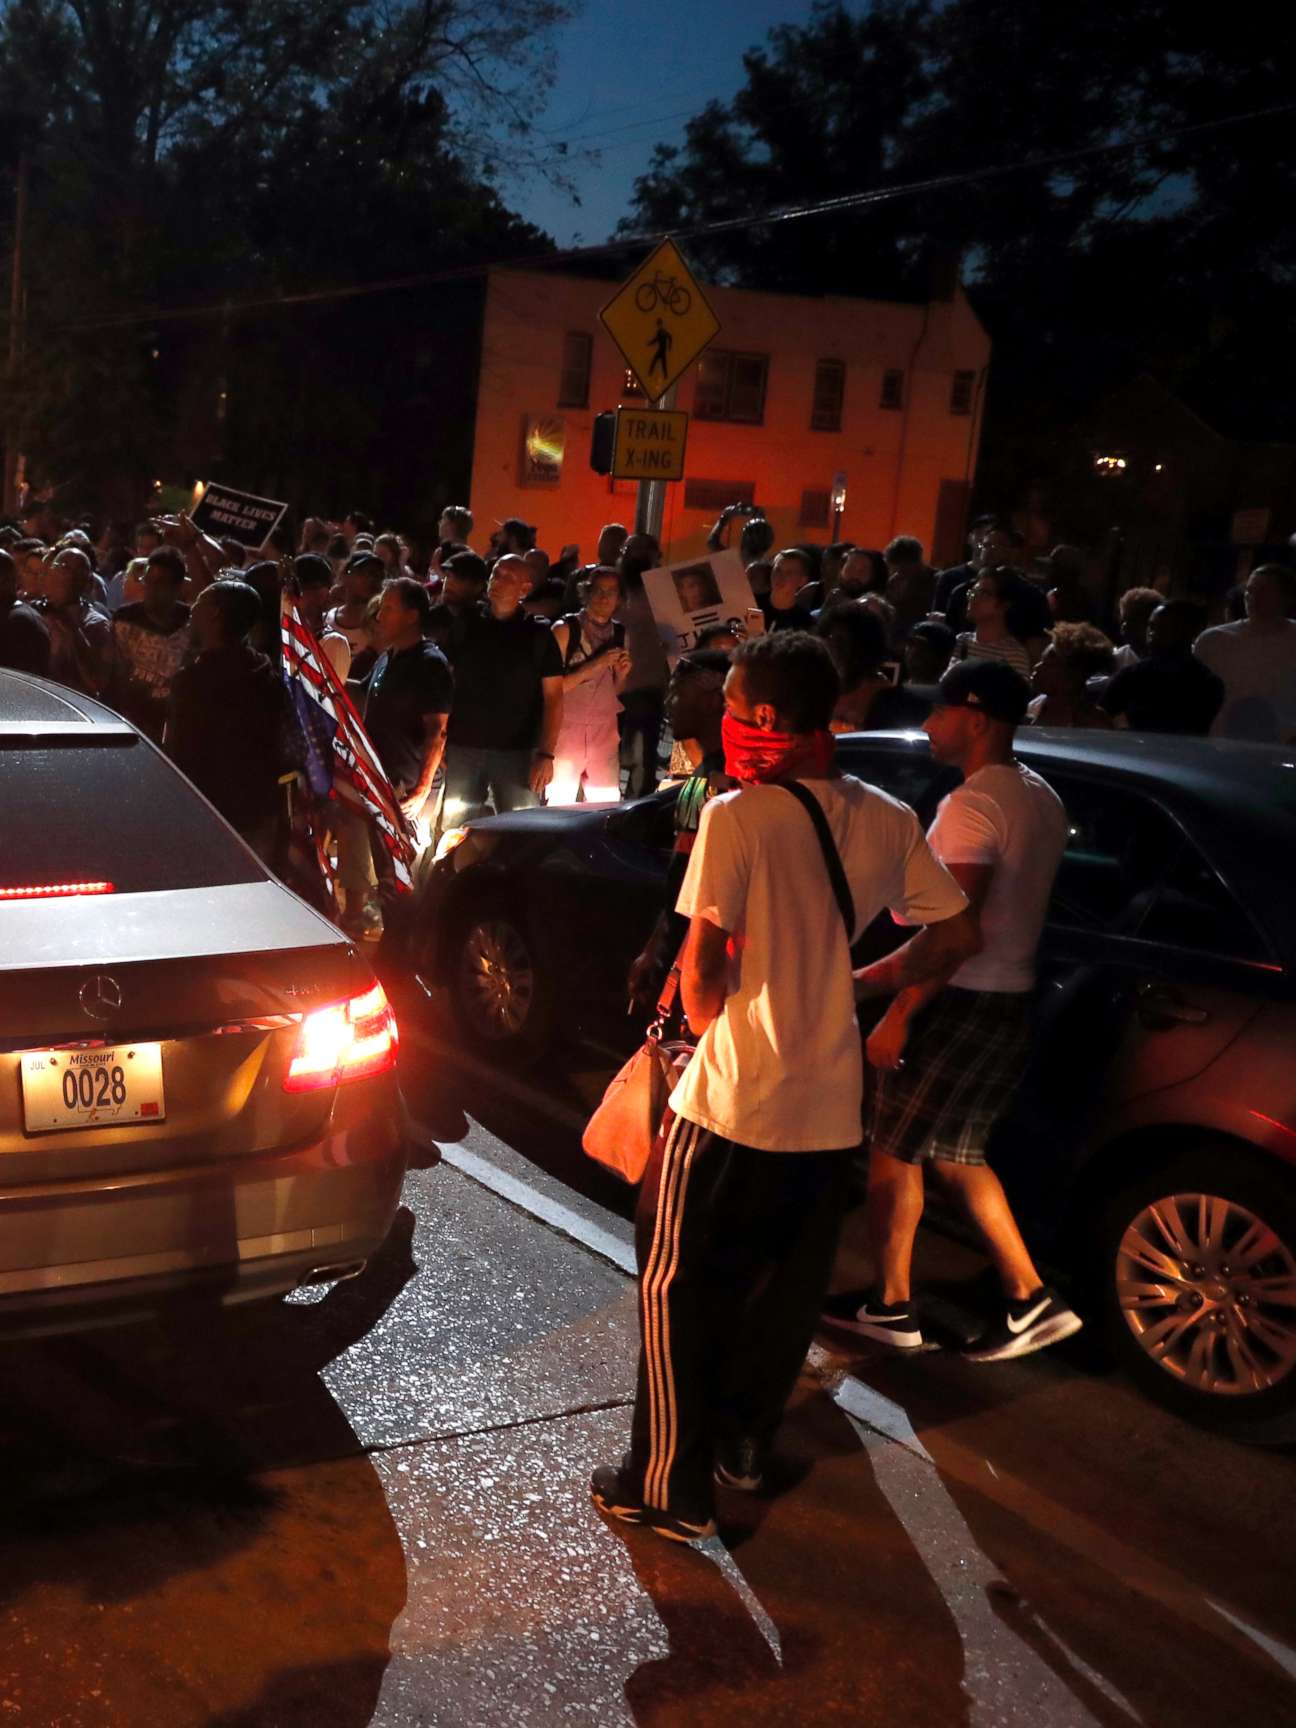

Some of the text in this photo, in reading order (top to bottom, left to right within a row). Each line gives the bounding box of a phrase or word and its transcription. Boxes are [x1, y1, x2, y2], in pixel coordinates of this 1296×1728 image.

[625, 419, 675, 441] TRAIL
[625, 448, 672, 469] X-ING
[30, 1061, 45, 1070] JUL
[70, 1051, 114, 1064] Missouri
[62, 1066, 126, 1109] 0028
